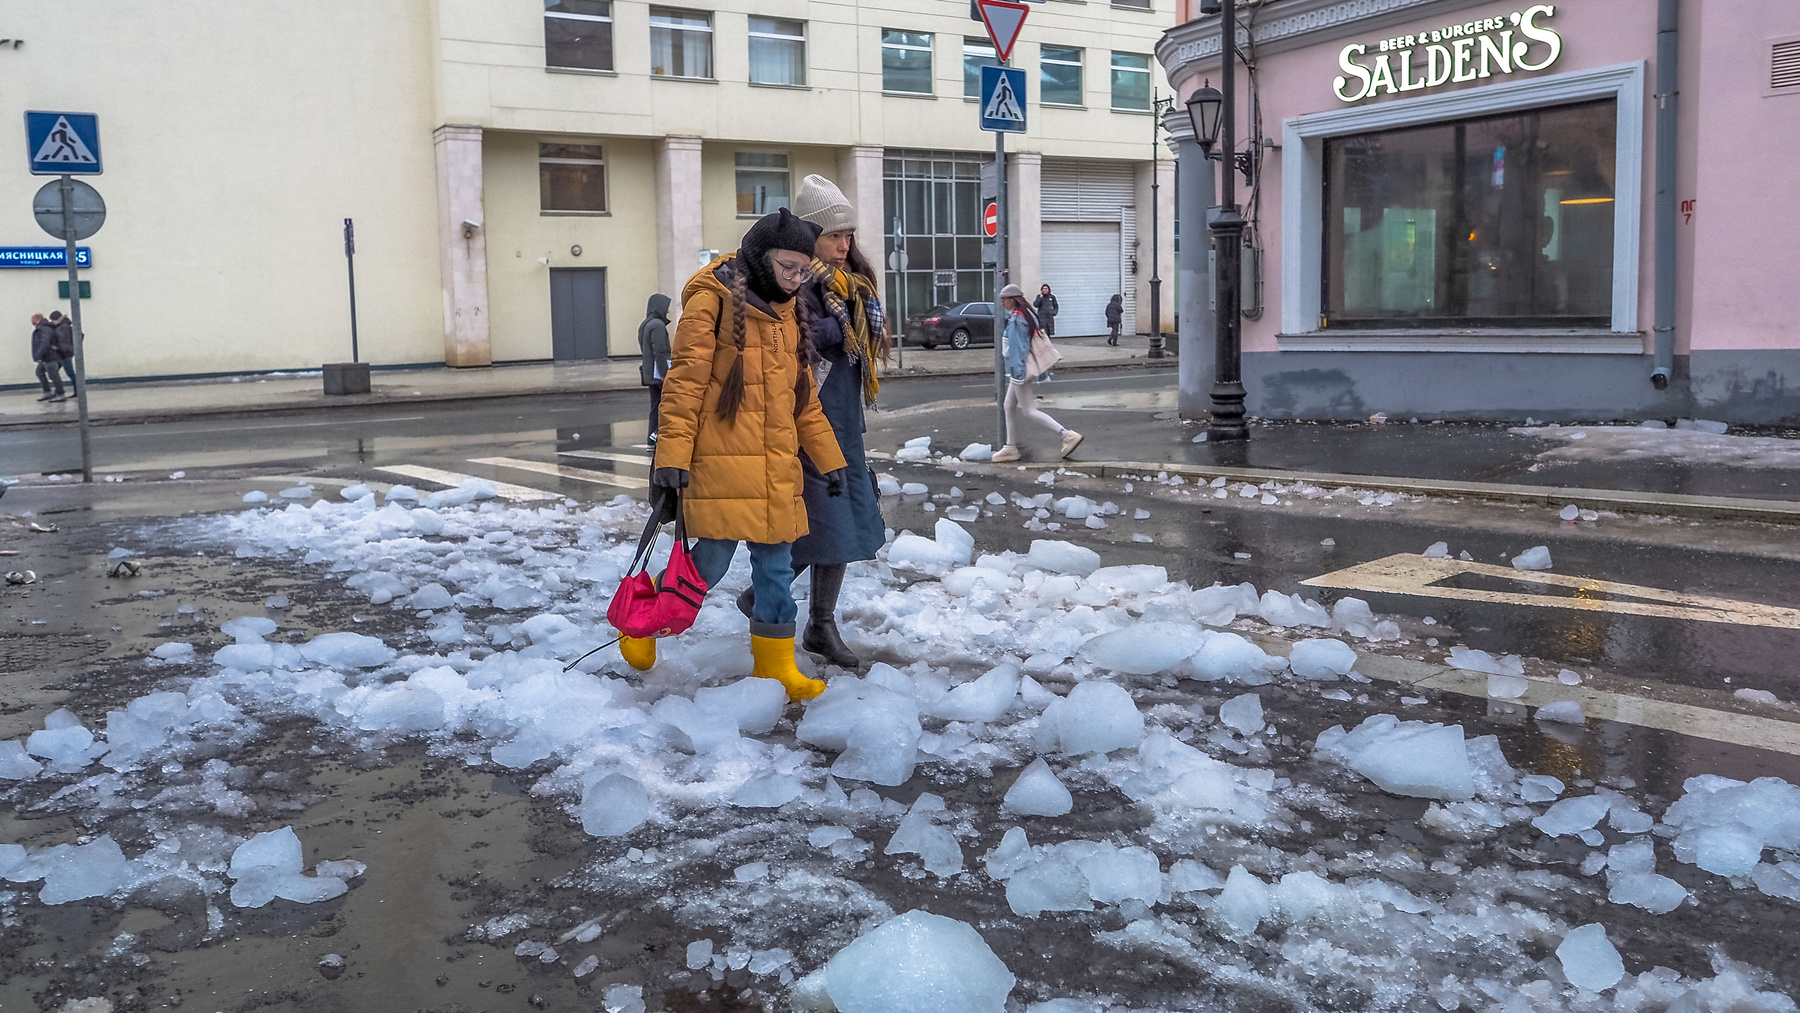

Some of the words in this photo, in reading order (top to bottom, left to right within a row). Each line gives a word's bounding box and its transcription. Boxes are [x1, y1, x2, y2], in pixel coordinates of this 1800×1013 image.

[1333, 5, 1561, 102] SALDEN'S
[1379, 34, 1416, 52] BEER
[1418, 31, 1430, 44] &
[1431, 16, 1504, 41] BURGERS
